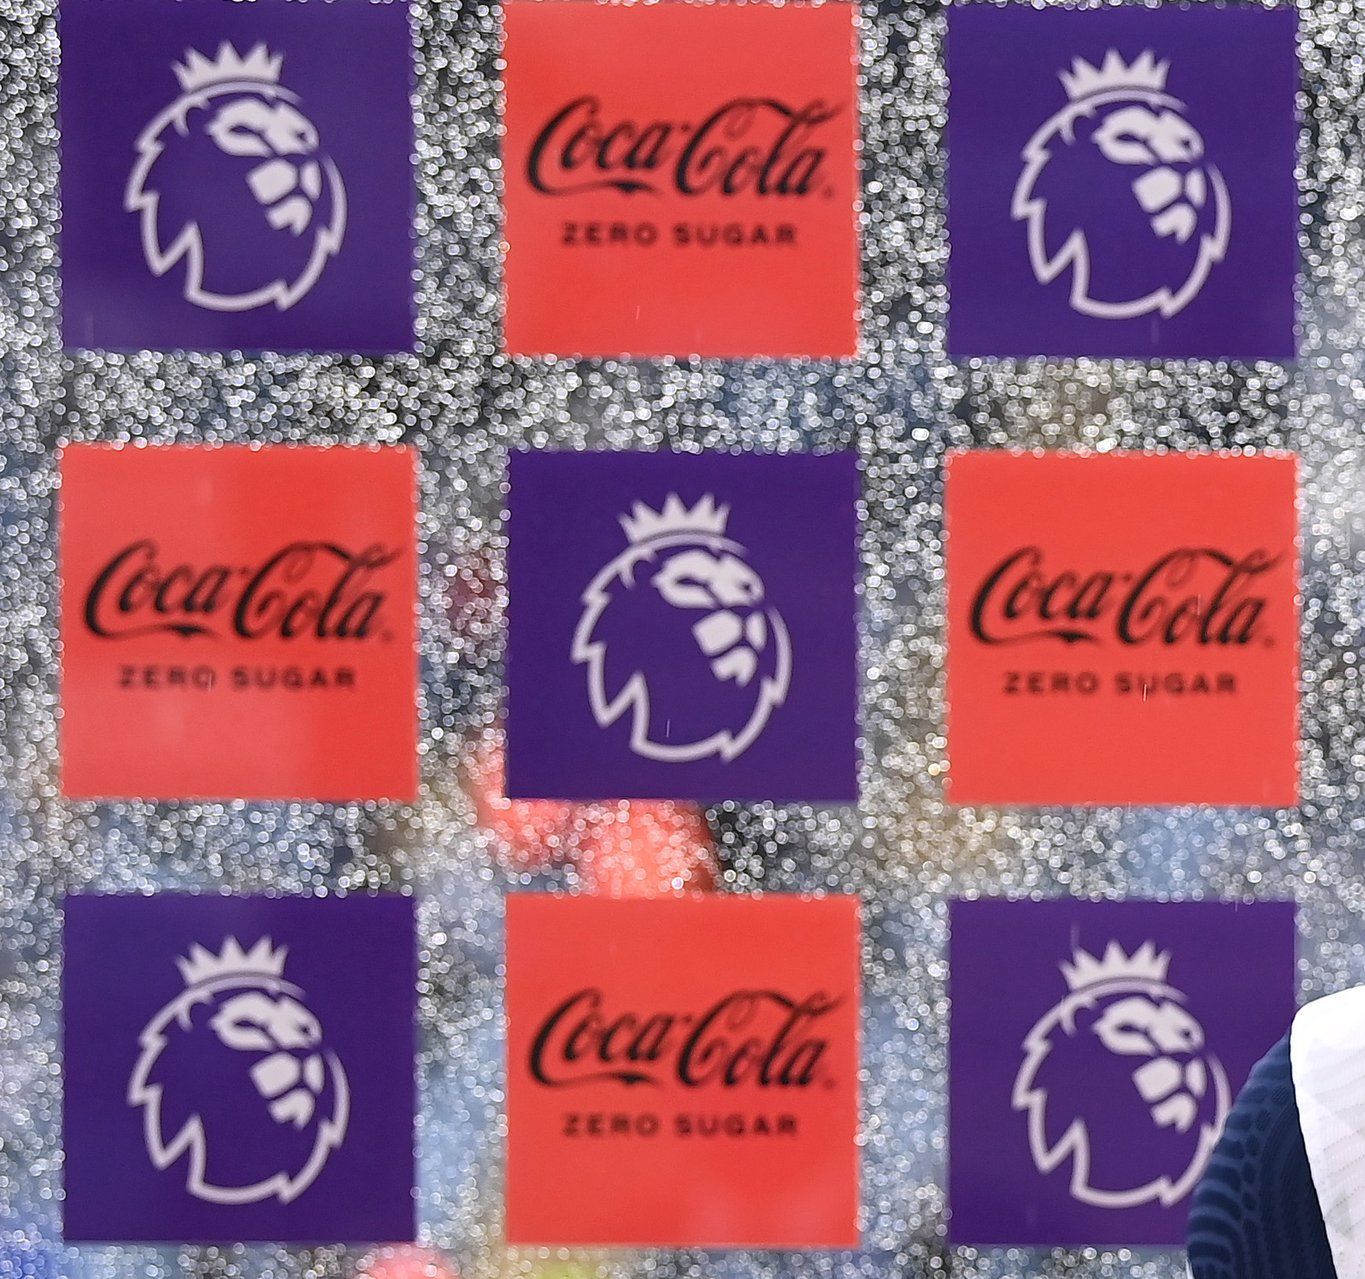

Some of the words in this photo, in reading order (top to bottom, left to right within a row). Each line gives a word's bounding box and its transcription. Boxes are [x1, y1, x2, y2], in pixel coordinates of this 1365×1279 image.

[524, 96, 841, 198] Coca-Cola
[562, 222, 658, 246] ZERO
[673, 222, 796, 246] SUGAR
[81, 540, 400, 642] Coca-Cola
[967, 547, 1280, 647] Coca-Cola
[119, 665, 216, 691] ZERO
[231, 665, 355, 691] SUGAR
[1004, 672, 1099, 696] ZERO
[1115, 672, 1236, 696] SUGAR
[526, 989, 841, 1089] Coca-Cola
[563, 1114, 660, 1137] ZERO
[674, 1114, 797, 1137] SUGAR
